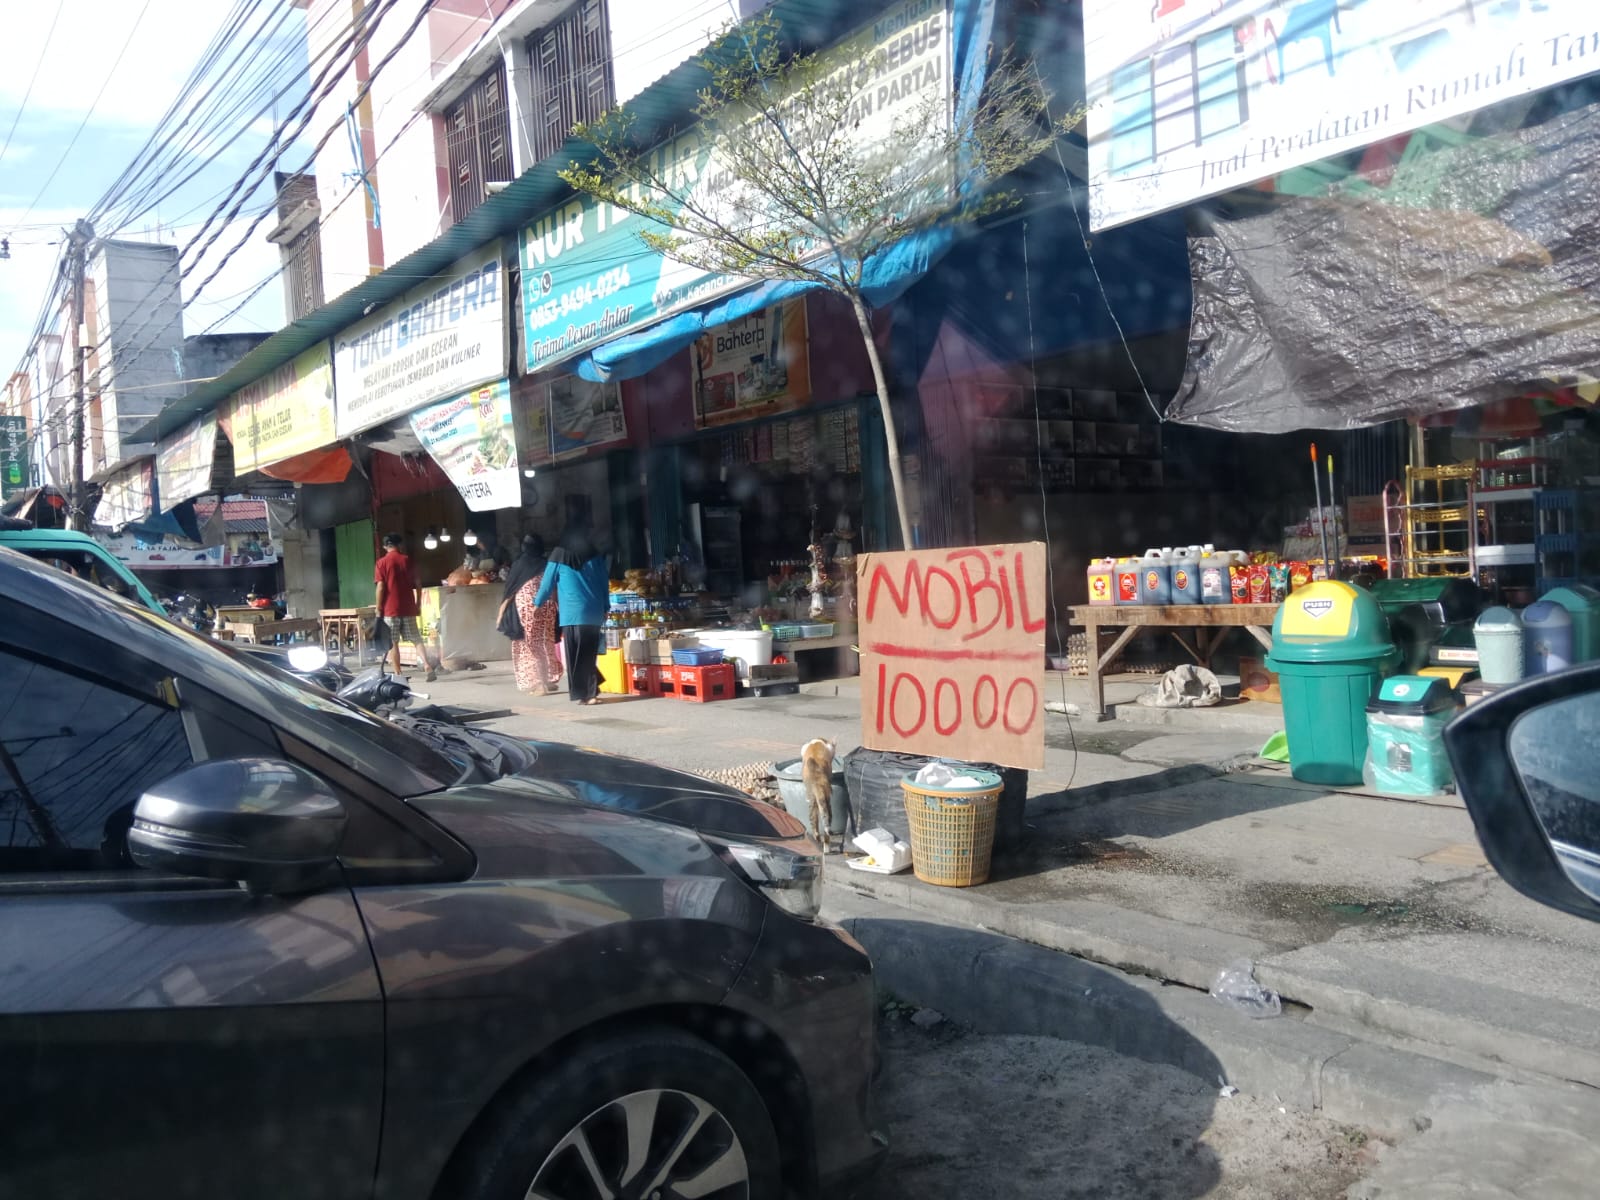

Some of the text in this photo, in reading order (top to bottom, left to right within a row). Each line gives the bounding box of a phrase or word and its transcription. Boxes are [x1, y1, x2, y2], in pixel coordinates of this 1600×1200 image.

[875, 15, 943, 80] REBUS
[877, 56, 941, 111] PARTAI
[1200, 143, 1248, 188] Jual
[1260, 104, 1391, 163] Peralatan
[1405, 41, 1525, 116] Rumah
[525, 200, 584, 270] NUR
[591, 133, 700, 233] TELUR
[687, 273, 724, 300] Kacang
[351, 261, 498, 373] TOKO BAHTERA
[532, 303, 634, 366] Terima Pesan Antar
[716, 327, 765, 354] Bahtera
[406, 363, 435, 388] SEMBAKO
[435, 355, 449, 374] DAN
[450, 342, 482, 368] KULINER
[416, 346, 430, 365] DAN
[431, 333, 459, 359] ECERAN
[1304, 601, 1331, 609] PUSH
[876, 663, 1038, 739] 10000
